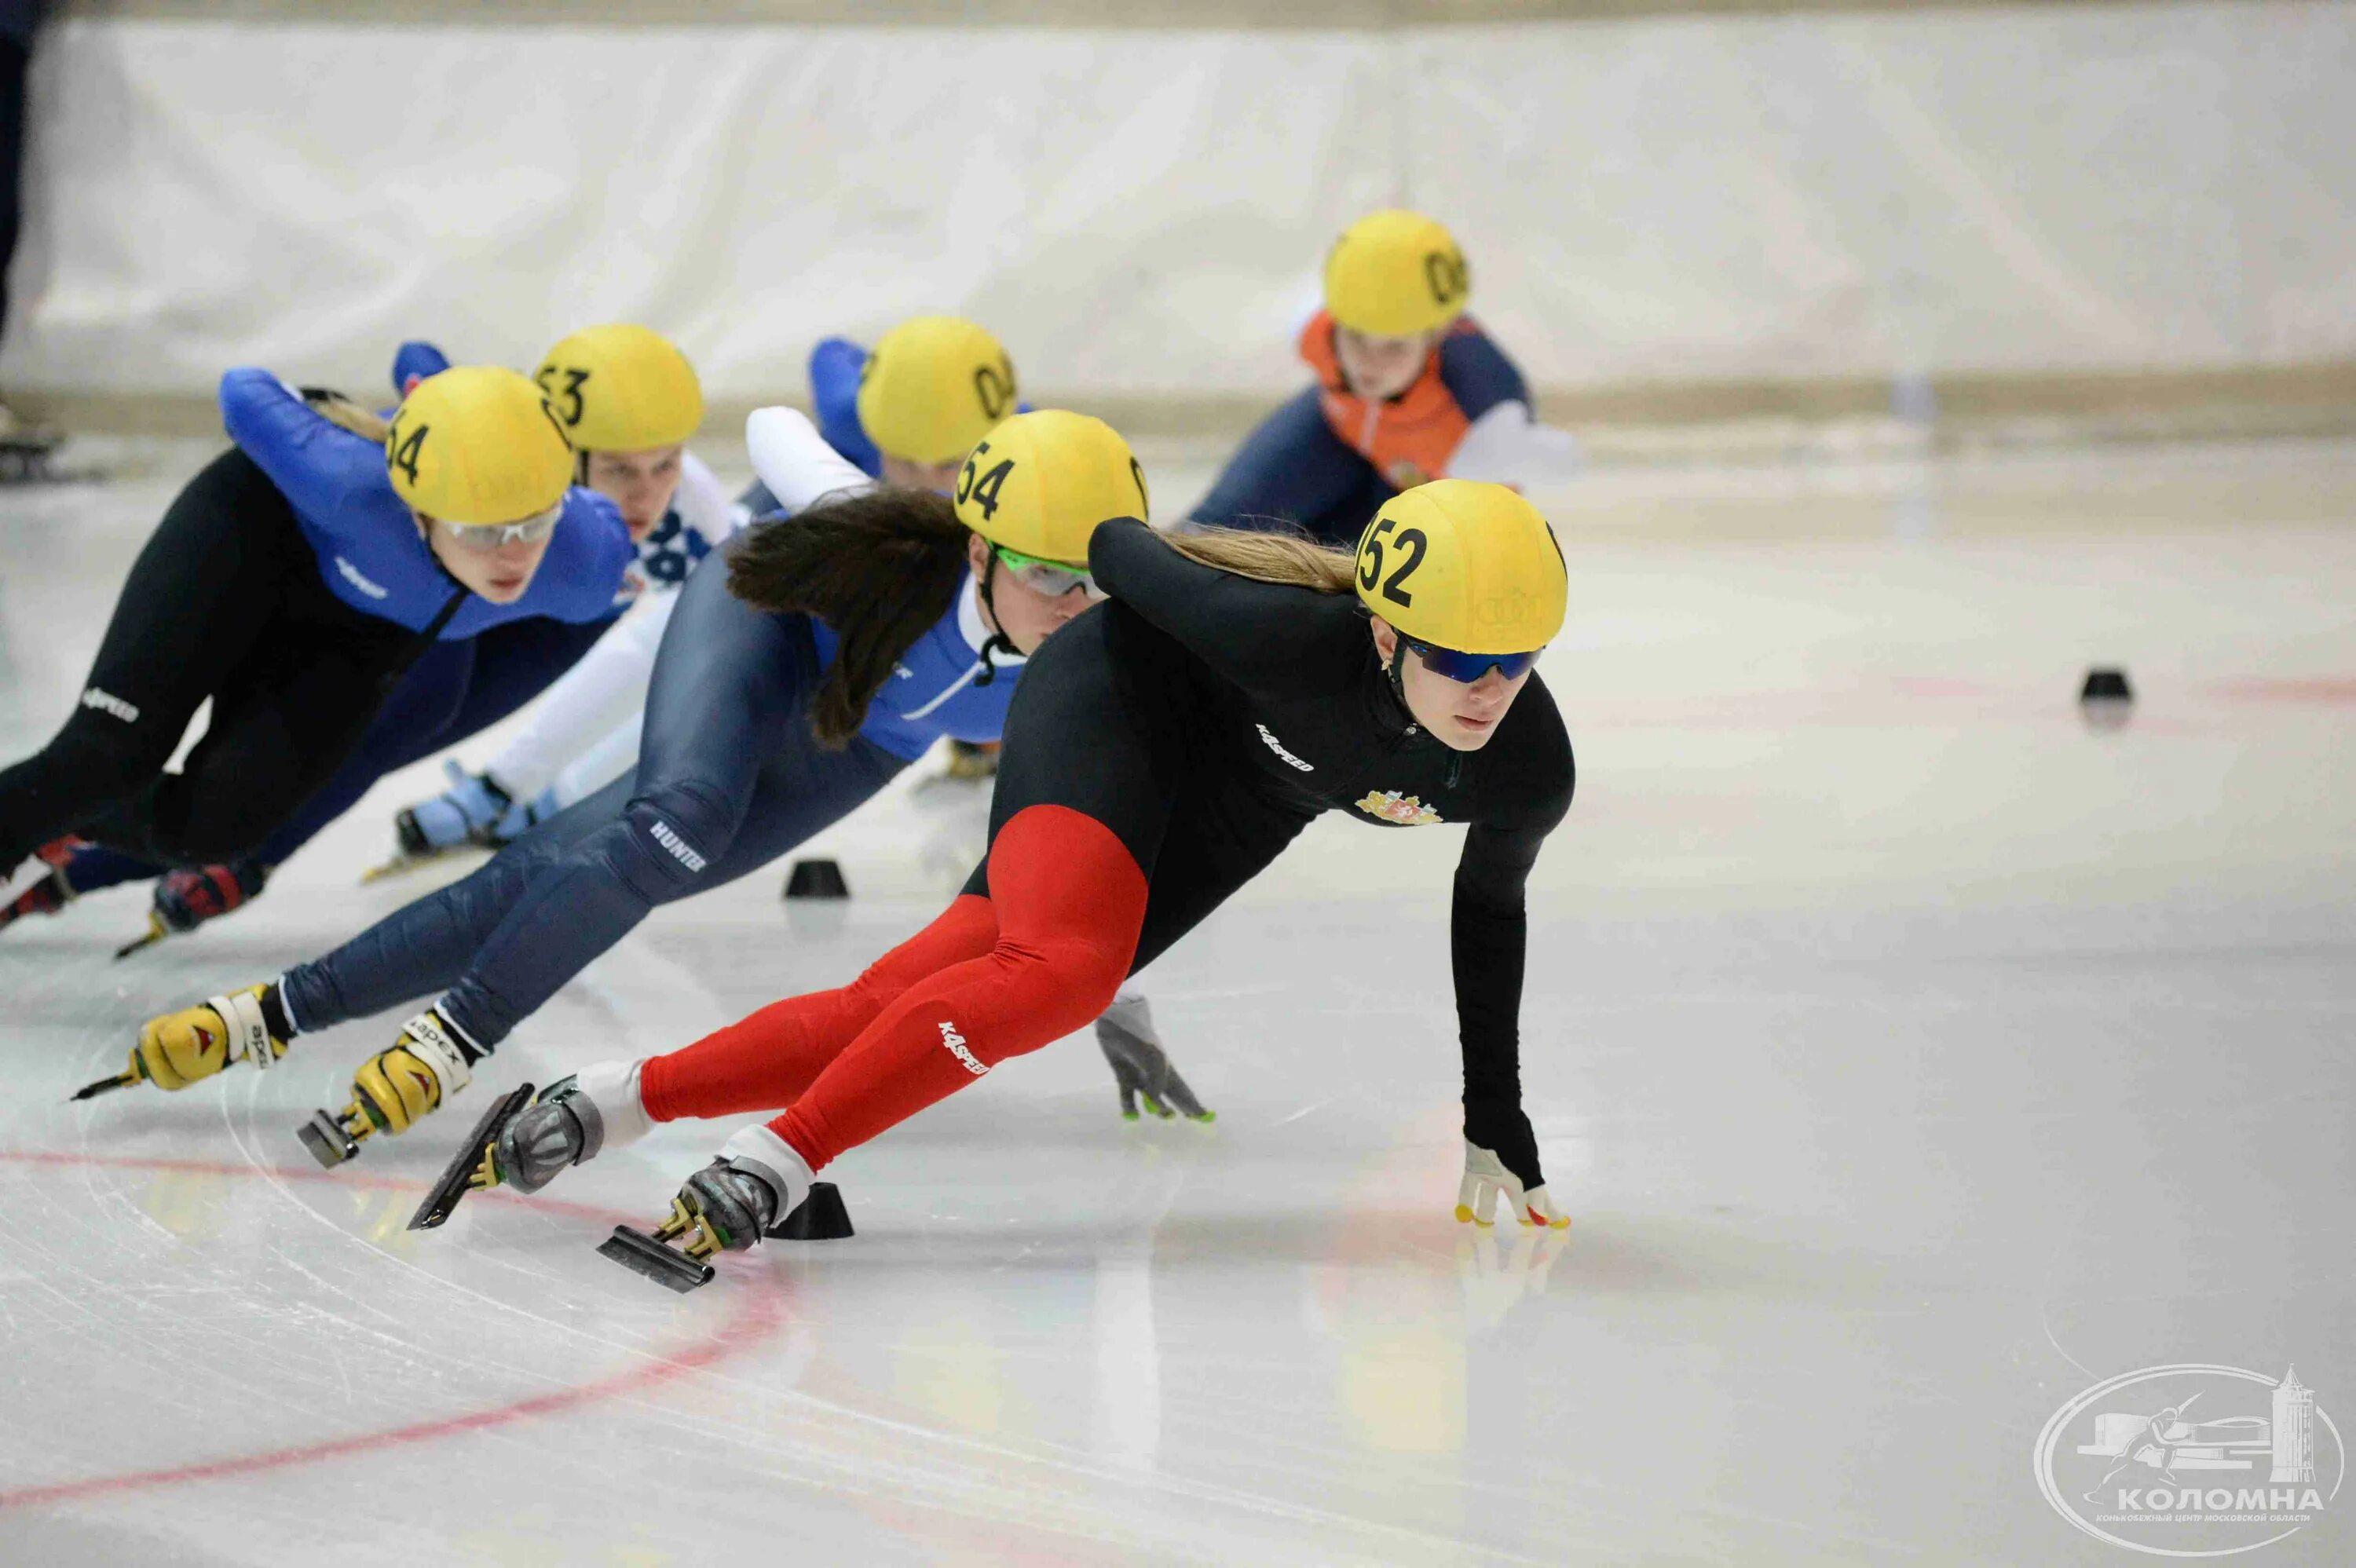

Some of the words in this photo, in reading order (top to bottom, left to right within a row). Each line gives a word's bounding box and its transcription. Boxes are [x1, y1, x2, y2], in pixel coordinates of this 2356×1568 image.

[389, 409, 429, 488] 4
[957, 442, 1015, 521] 54
[1355, 512, 1428, 609] 52
[1255, 723, 1315, 772] K4SPEED
[649, 821, 706, 873] HUNTER
[251, 1025, 268, 1070] ape
[418, 1023, 459, 1065] apex
